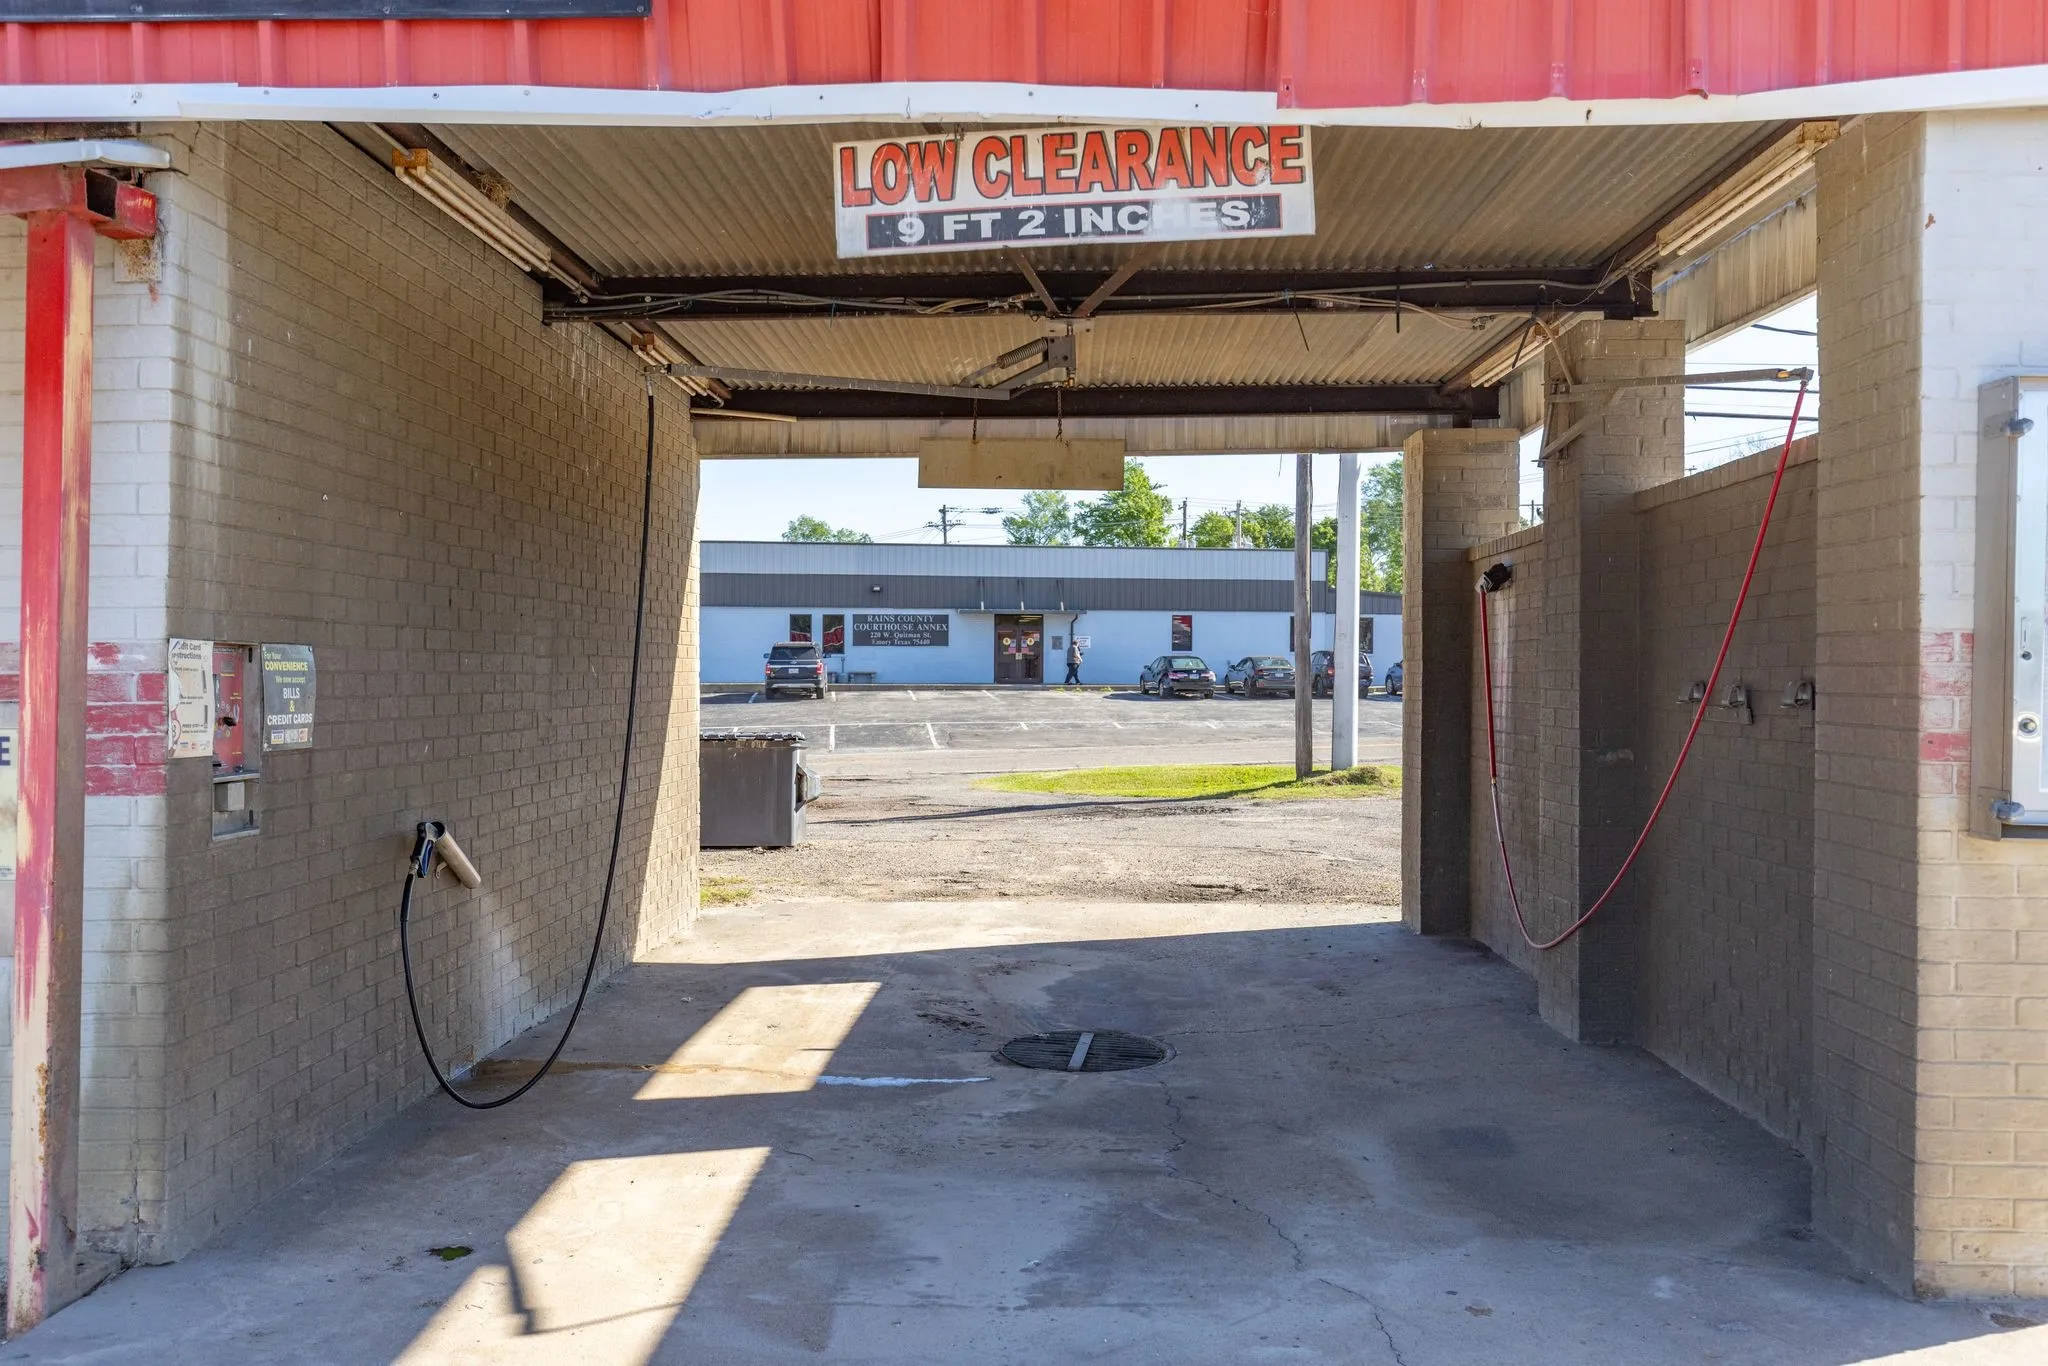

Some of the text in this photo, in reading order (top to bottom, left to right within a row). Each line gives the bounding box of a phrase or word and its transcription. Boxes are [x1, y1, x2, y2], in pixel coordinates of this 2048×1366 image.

[840, 125, 1304, 207] LOW CLEARANCE
[898, 217, 926, 246] 9
[942, 212, 1002, 241] FT
[1018, 209, 1046, 236] 2
[854, 623, 948, 631] COURTHOUSE ANNEX
[264, 660, 309, 671] CONVENIENCE
[283, 687, 300, 699] BILLS
[267, 713, 313, 725] CREDIT CARDS
